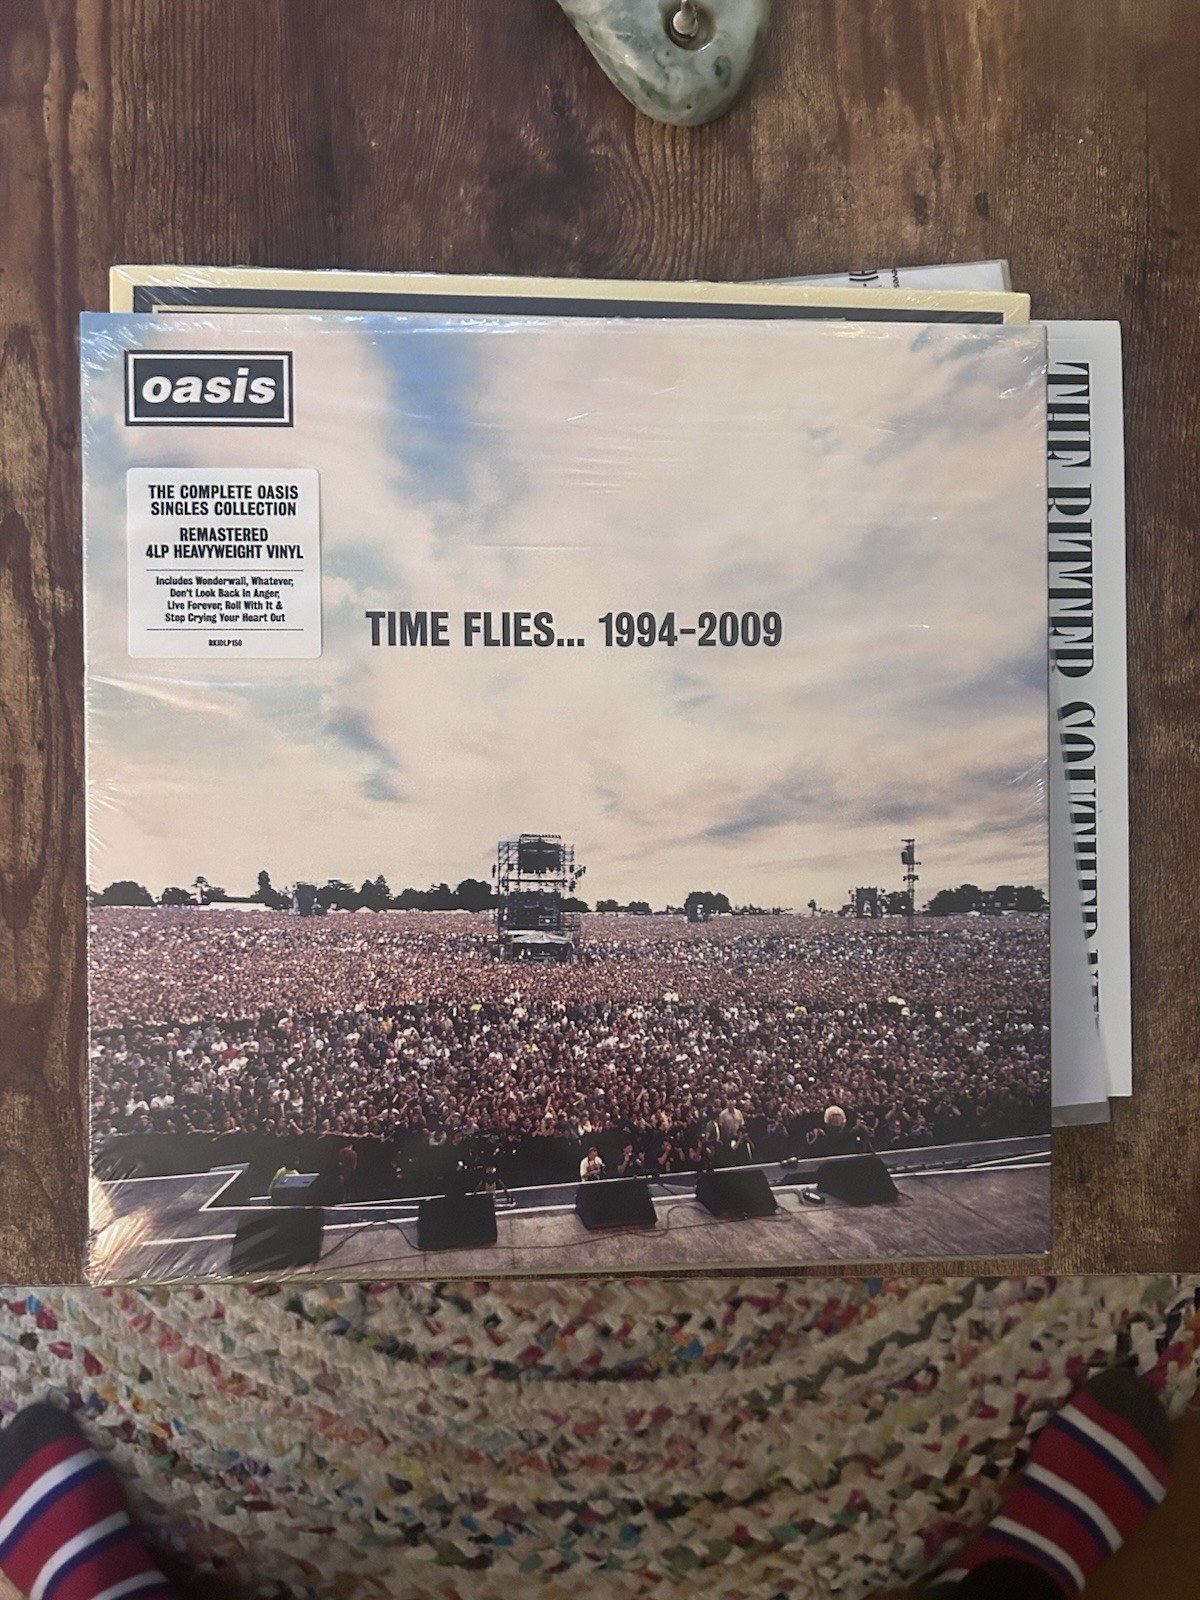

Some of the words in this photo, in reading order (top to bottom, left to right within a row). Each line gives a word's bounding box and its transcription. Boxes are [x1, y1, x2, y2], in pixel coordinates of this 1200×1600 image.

[142, 367, 276, 405] oasis
[149, 485, 175, 498] THE
[181, 485, 252, 498] COMPLETE
[258, 486, 298, 499] OASIS
[151, 502, 208, 515] SINGLES
[215, 502, 296, 515] COLLECTION
[180, 528, 268, 541] REMASTERED
[146, 545, 169, 558] 4LP
[175, 545, 262, 558] HEAVYWEIGHT
[267, 545, 303, 558] VINYL
[156, 577, 192, 585] Includes
[196, 577, 248, 586] Wonderwall,
[252, 577, 293, 586] Whatever,
[170, 589, 192, 597] Don't
[196, 589, 215, 597] Look
[219, 589, 239, 597] Back
[243, 589, 251, 597] In
[254, 589, 280, 599] Anger,
[168, 601, 184, 609] Live
[188, 601, 222, 611] Forever,
[226, 601, 241, 609] Roll
[244, 601, 263, 609] With
[266, 601, 273, 609] It
[276, 601, 283, 609] &
[165, 613, 185, 623] Stop
[188, 613, 217, 623] Crying
[220, 613, 239, 622] Your
[243, 613, 267, 622] Heart
[271, 613, 285, 622] Out
[365, 611, 450, 647] TIME
[463, 611, 585, 647] FLIES...
